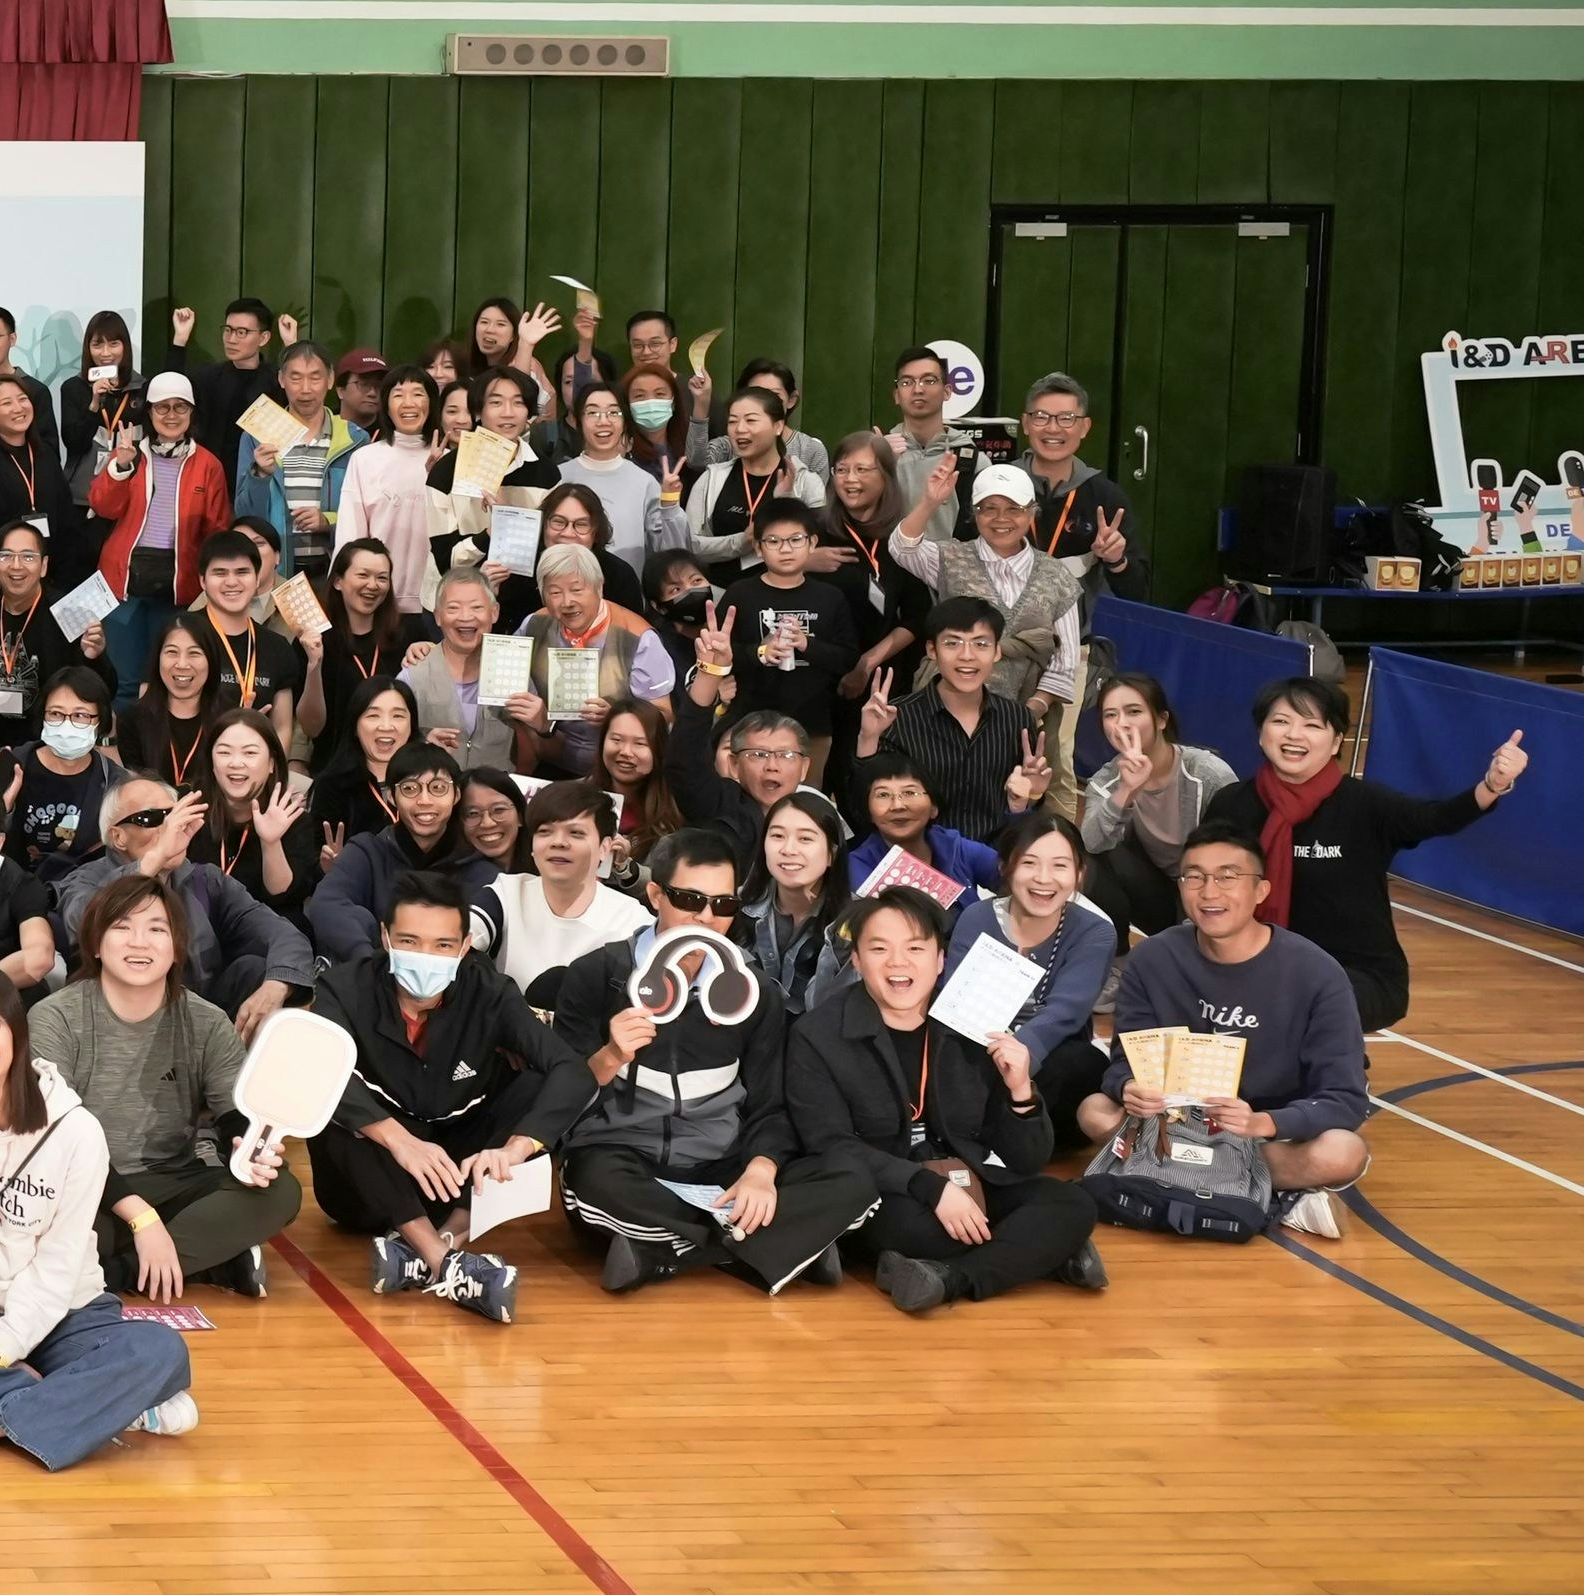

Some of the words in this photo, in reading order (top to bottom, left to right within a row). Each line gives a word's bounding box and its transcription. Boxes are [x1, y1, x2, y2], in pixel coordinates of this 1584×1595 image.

[1481, 496, 1497, 505] TV
[1293, 845, 1311, 858] THE
[1315, 844, 1342, 858] DARK
